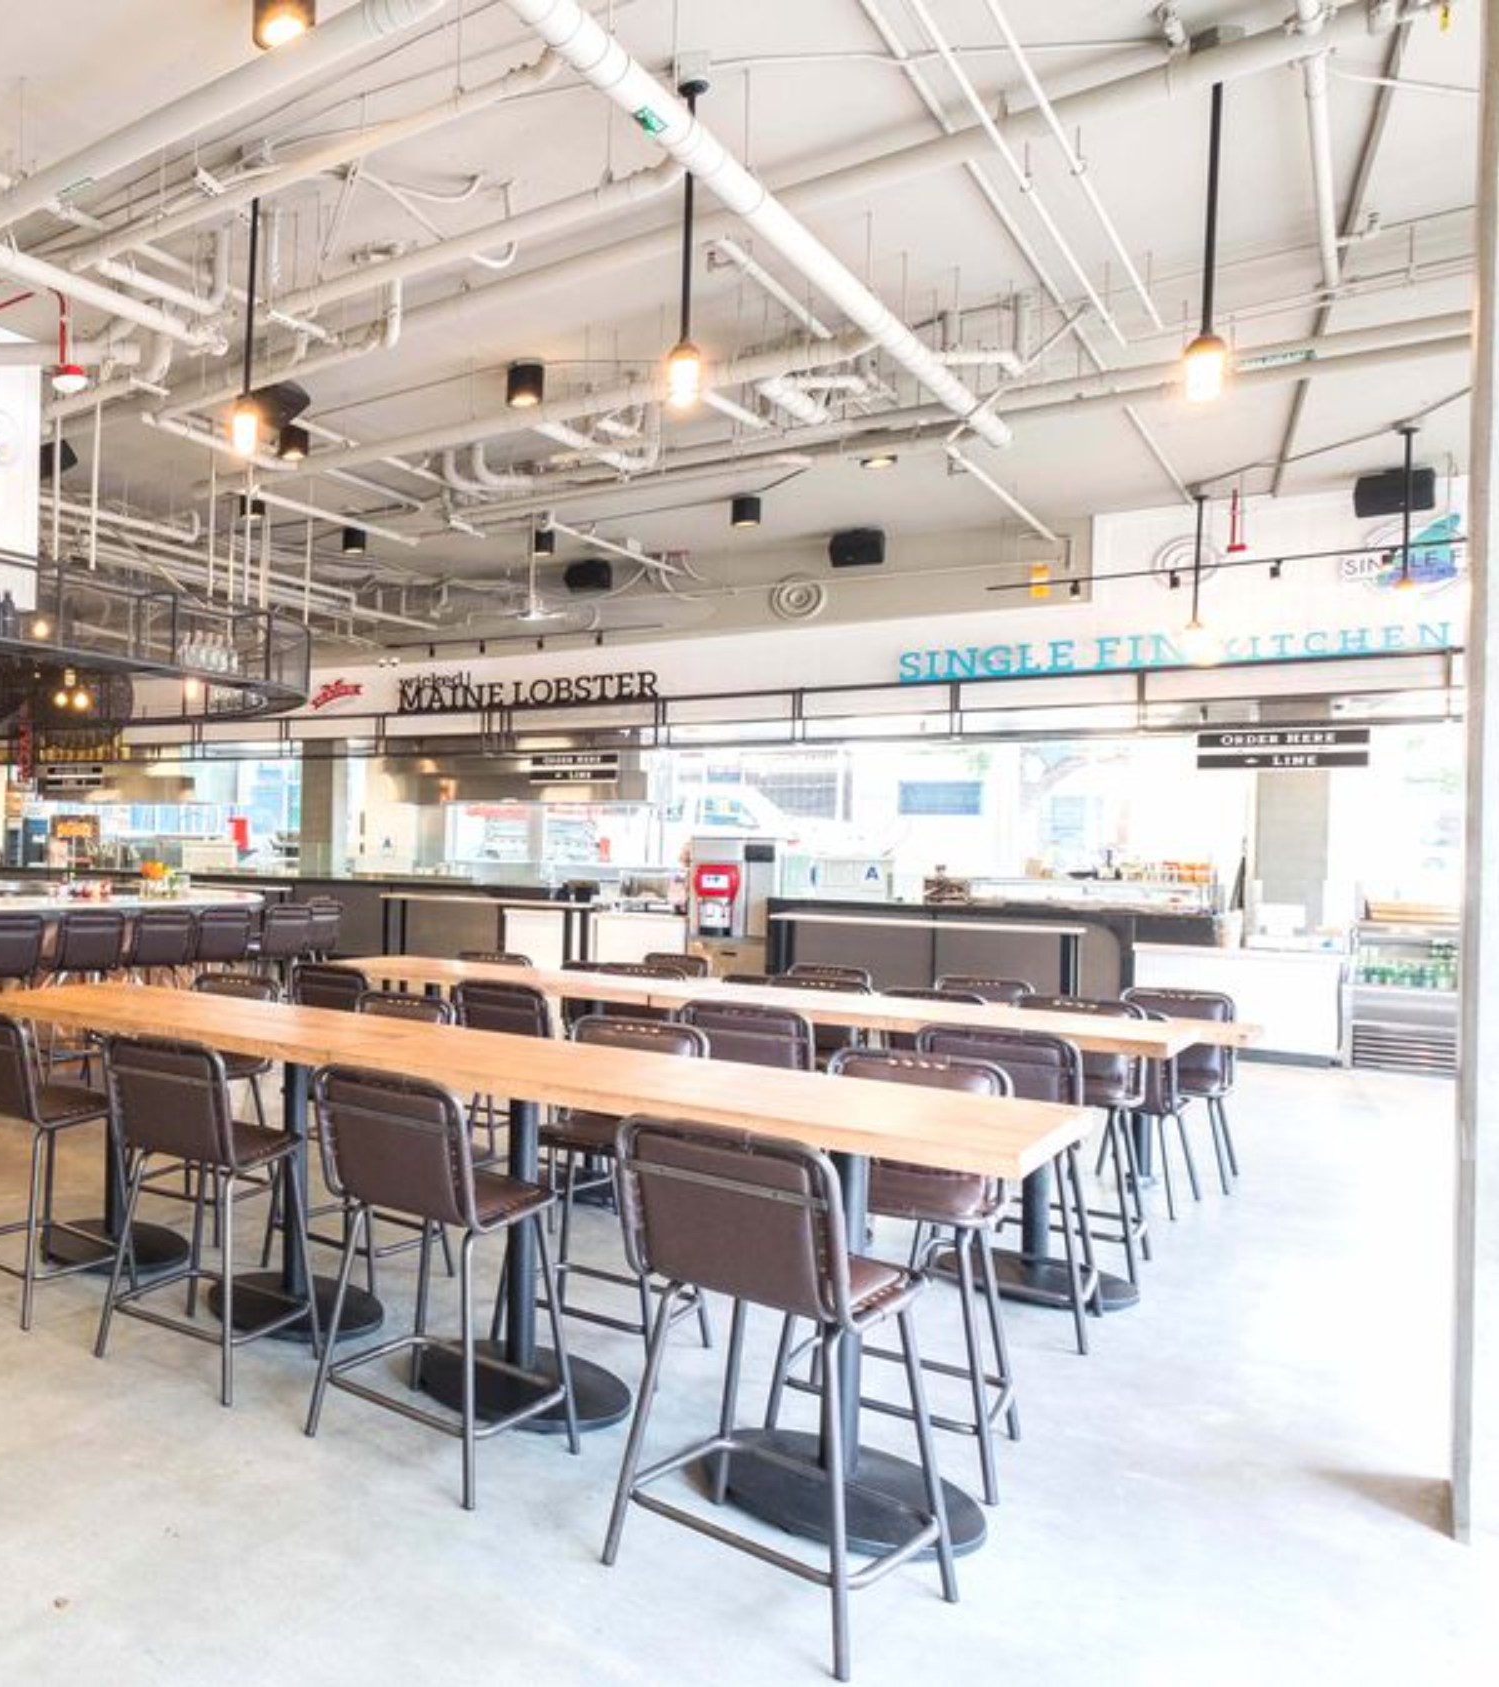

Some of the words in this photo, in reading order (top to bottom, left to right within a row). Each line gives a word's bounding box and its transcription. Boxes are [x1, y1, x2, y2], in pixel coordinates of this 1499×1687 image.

[1344, 548, 1440, 576] SINLE
[900, 640, 1075, 680] SINGLE
[398, 682, 504, 713] MAINE
[512, 671, 659, 709] LOBSTER
[1220, 733, 1280, 747] ORDER
[1285, 732, 1337, 745] HERE
[1271, 754, 1318, 767] LINE
